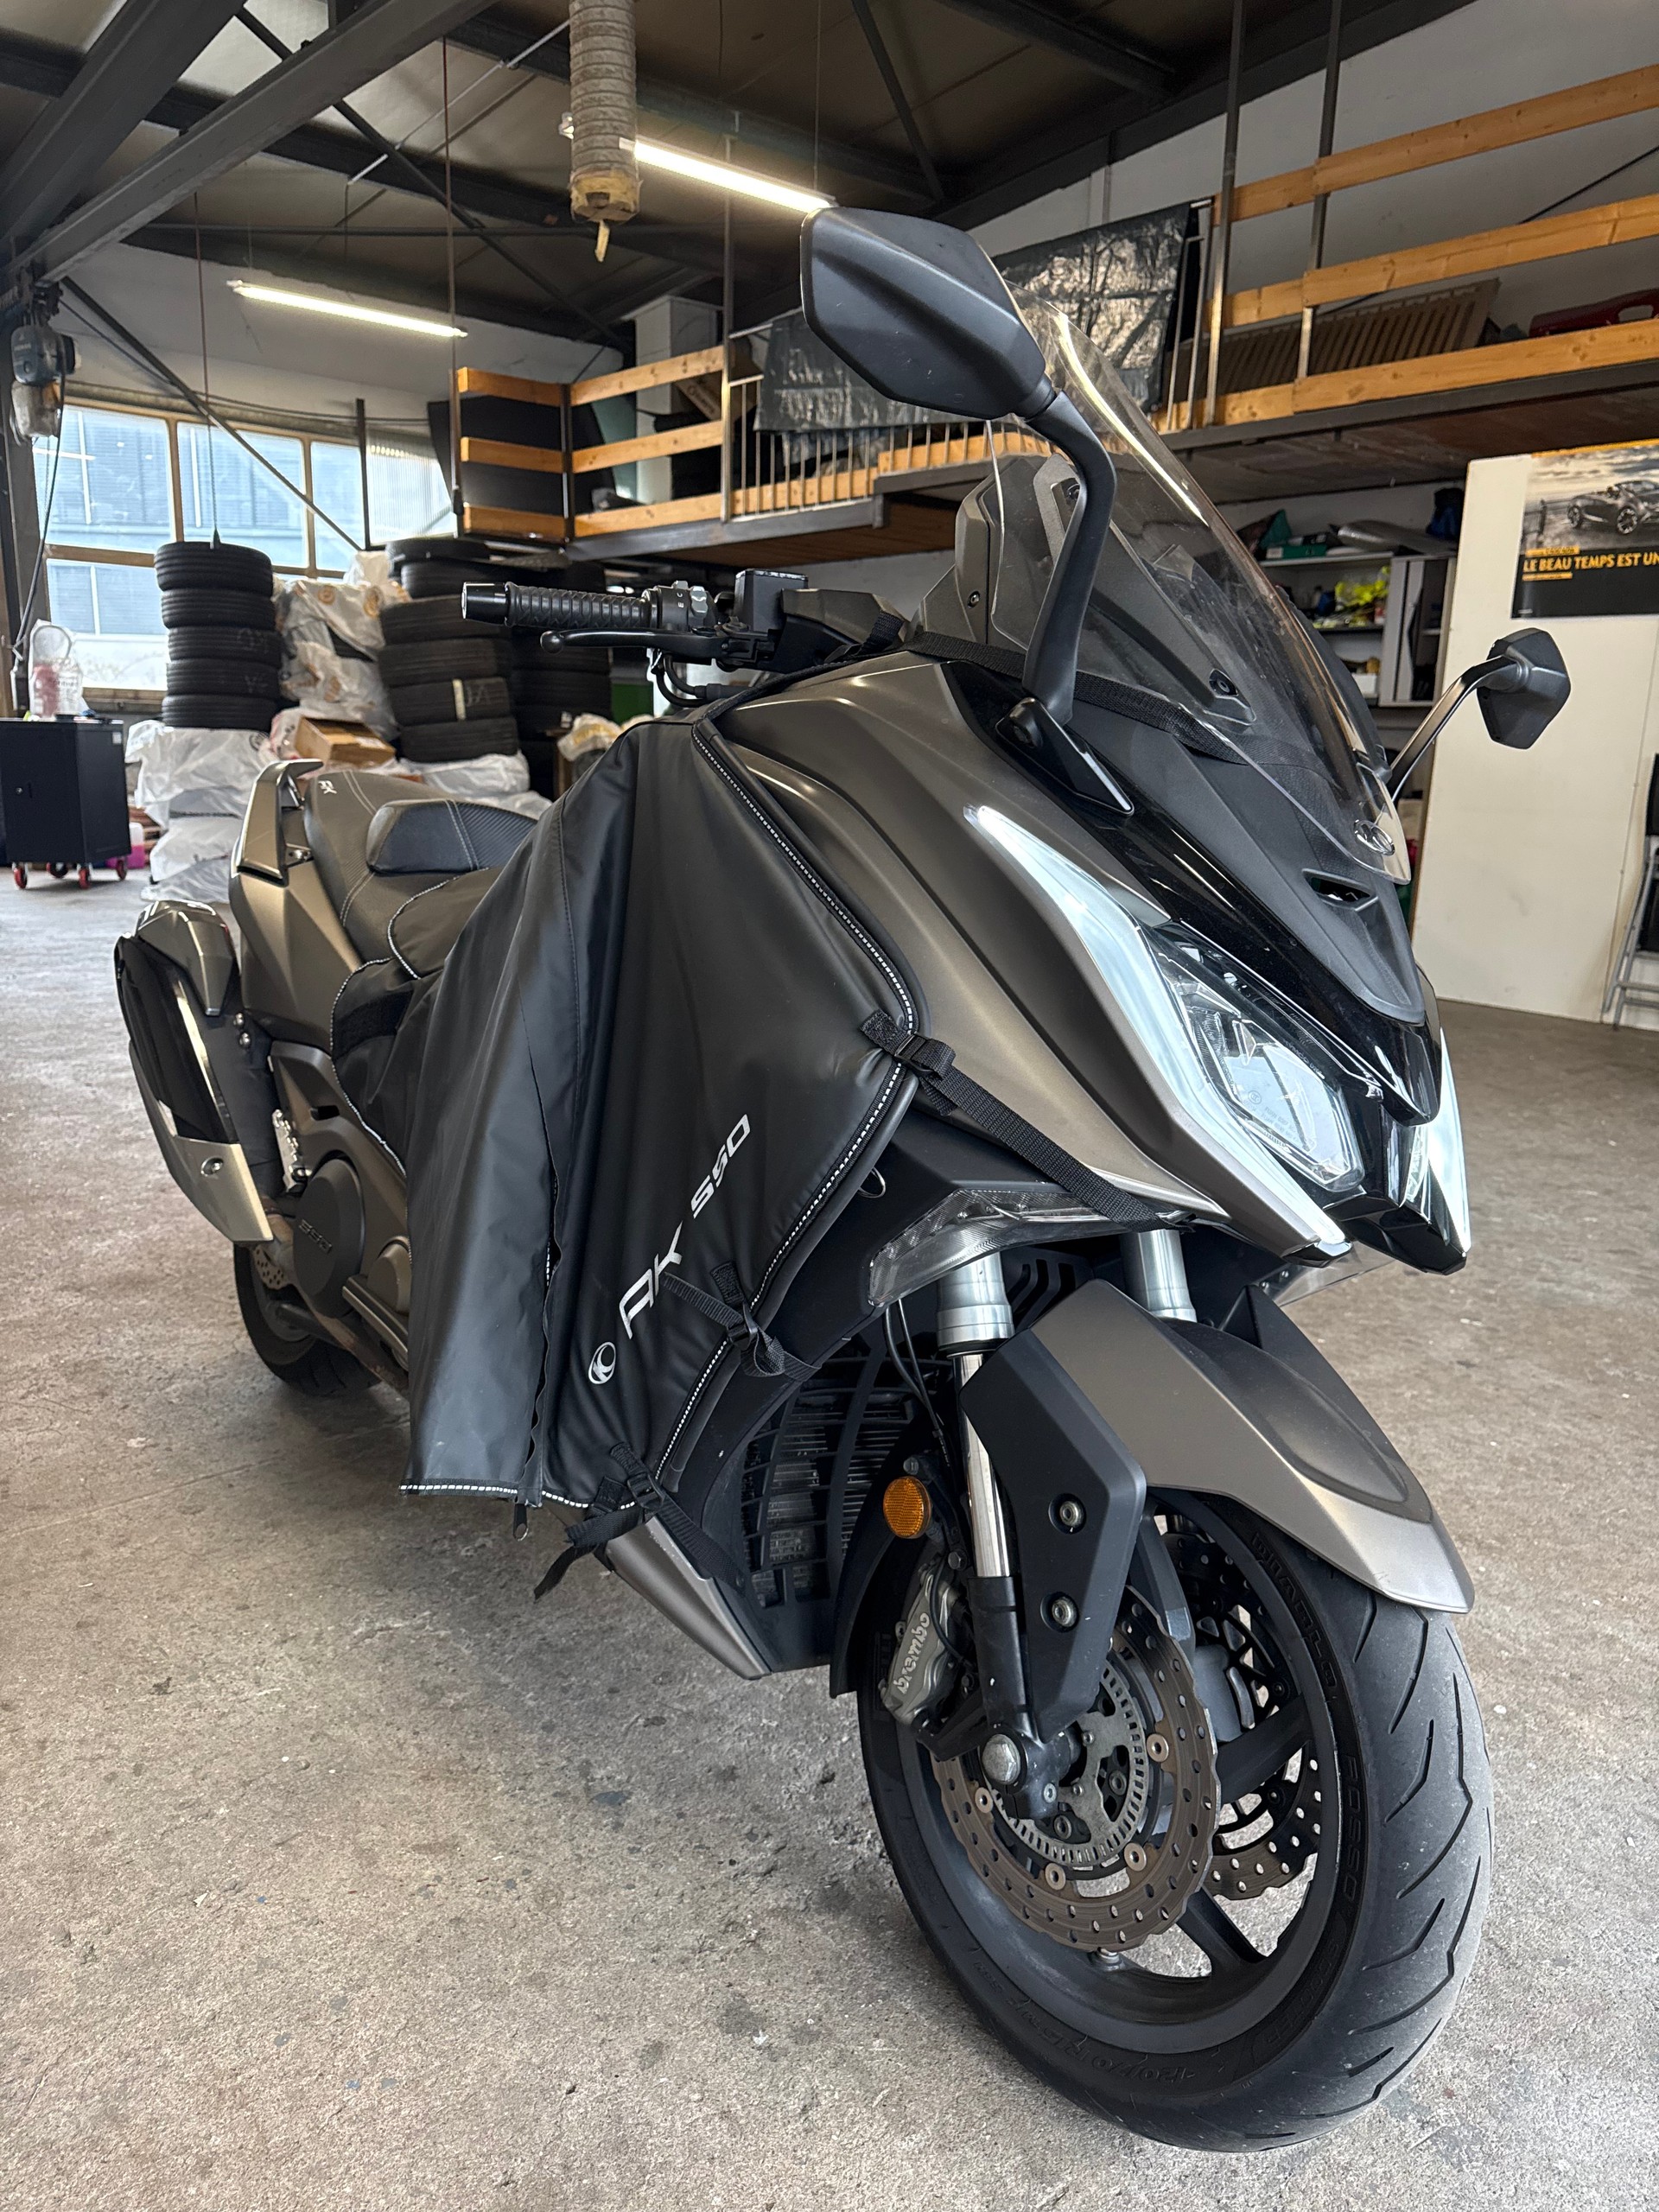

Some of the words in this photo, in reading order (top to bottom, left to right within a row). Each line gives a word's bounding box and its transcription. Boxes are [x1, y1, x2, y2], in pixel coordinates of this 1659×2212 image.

[1523, 559, 1538, 572] LE
[1539, 556, 1573, 571] BEAU
[1574, 554, 1615, 569] TEMPS
[1617, 553, 1642, 568] EST
[619, 1220, 683, 1340] AK
[690, 1114, 751, 1219] 550
[893, 1612, 931, 1694] brembo
[1343, 1754, 1363, 1902] ROSSO
